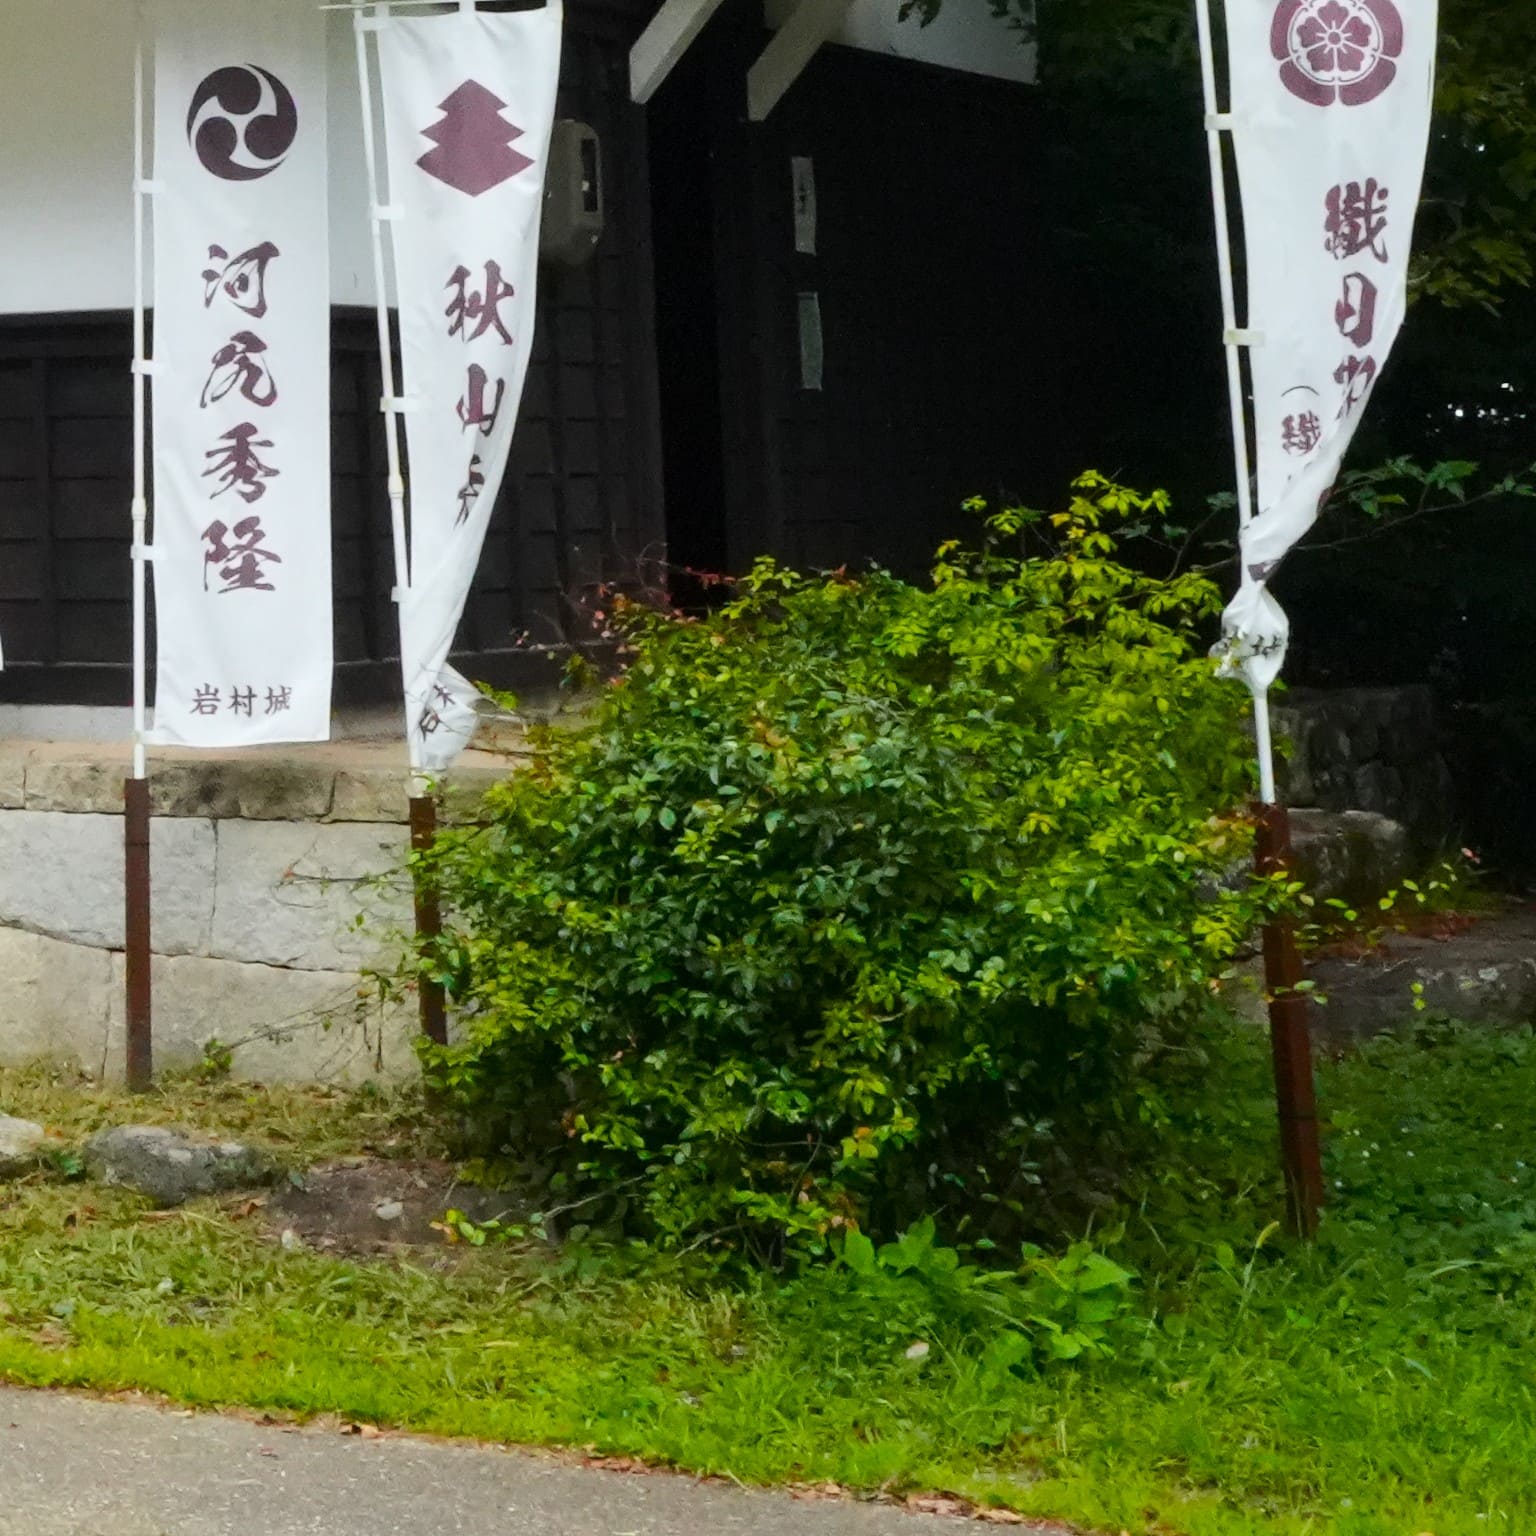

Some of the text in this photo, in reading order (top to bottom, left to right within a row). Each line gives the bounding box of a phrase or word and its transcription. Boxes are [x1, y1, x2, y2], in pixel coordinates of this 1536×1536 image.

[199, 240, 283, 595] 河尻秀隆
[190, 682, 293, 719] 岩村城
